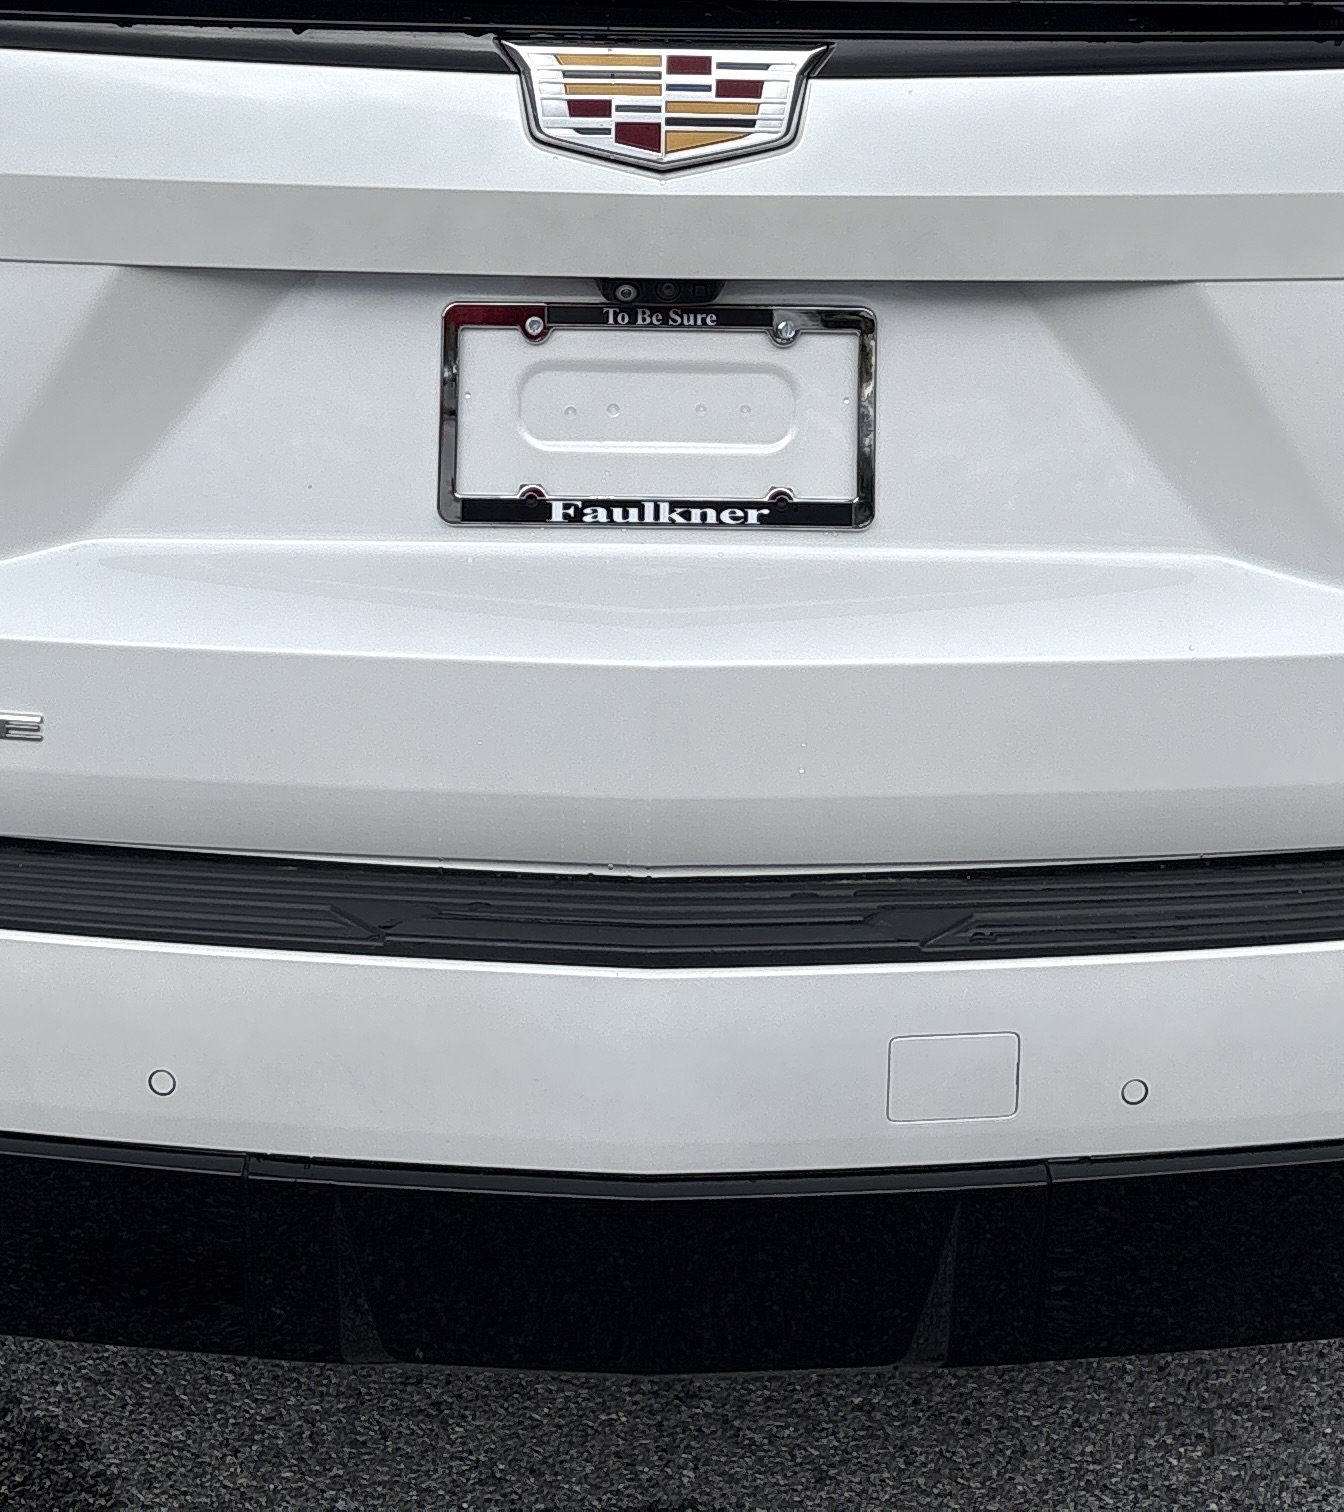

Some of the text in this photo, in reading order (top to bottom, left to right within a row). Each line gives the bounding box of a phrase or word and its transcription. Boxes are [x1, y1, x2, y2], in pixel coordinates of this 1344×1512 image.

[603, 308, 717, 326] To Be Sure
[546, 500, 771, 525] Faulkner
